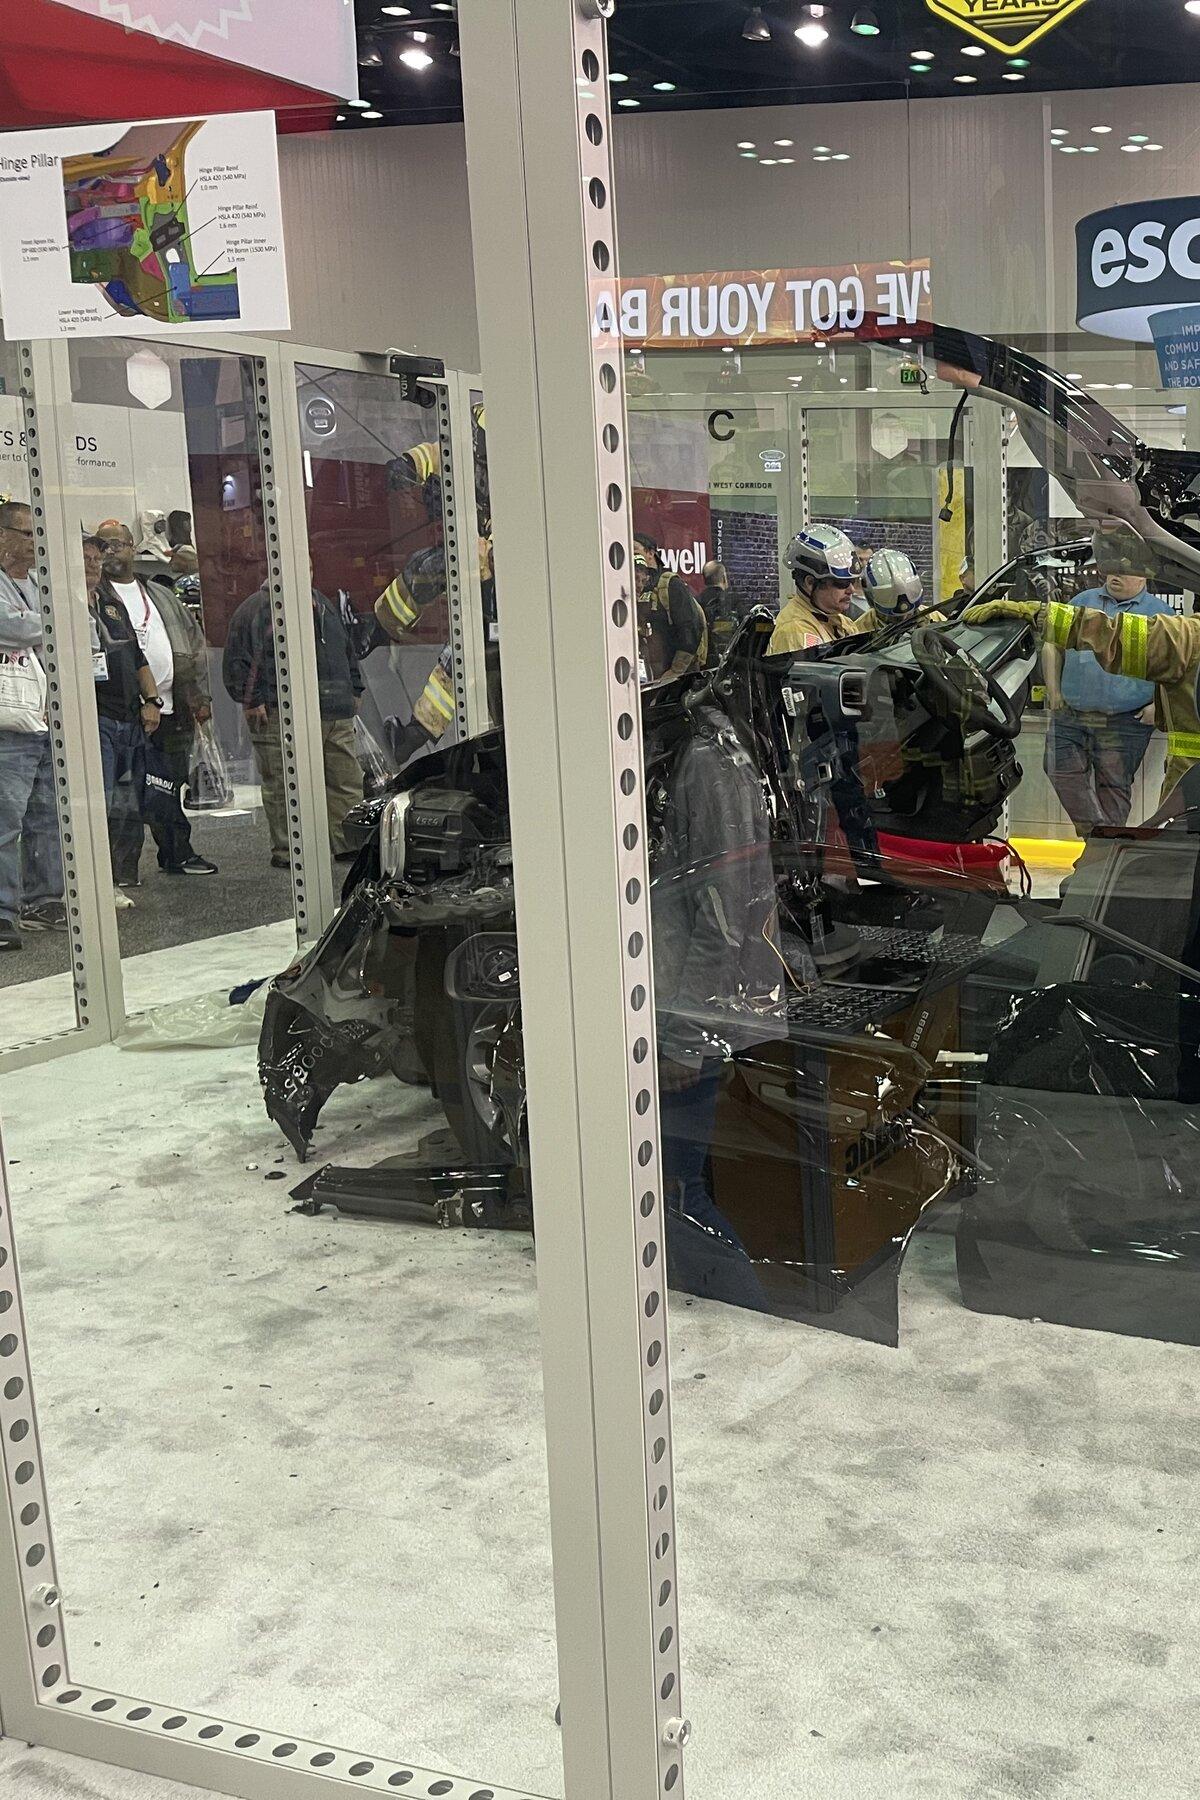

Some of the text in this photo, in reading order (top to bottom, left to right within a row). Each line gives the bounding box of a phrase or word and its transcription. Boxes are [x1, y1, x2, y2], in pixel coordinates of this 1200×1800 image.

[31, 153, 59, 168] Pillar
[1164, 360, 1179, 372] AND
[1168, 376, 1182, 388] THE
[708, 409, 735, 441] C
[0, 430, 14, 446] S
[75, 435, 98, 452] DS
[12, 453, 22, 462] to
[659, 541, 706, 575] well
